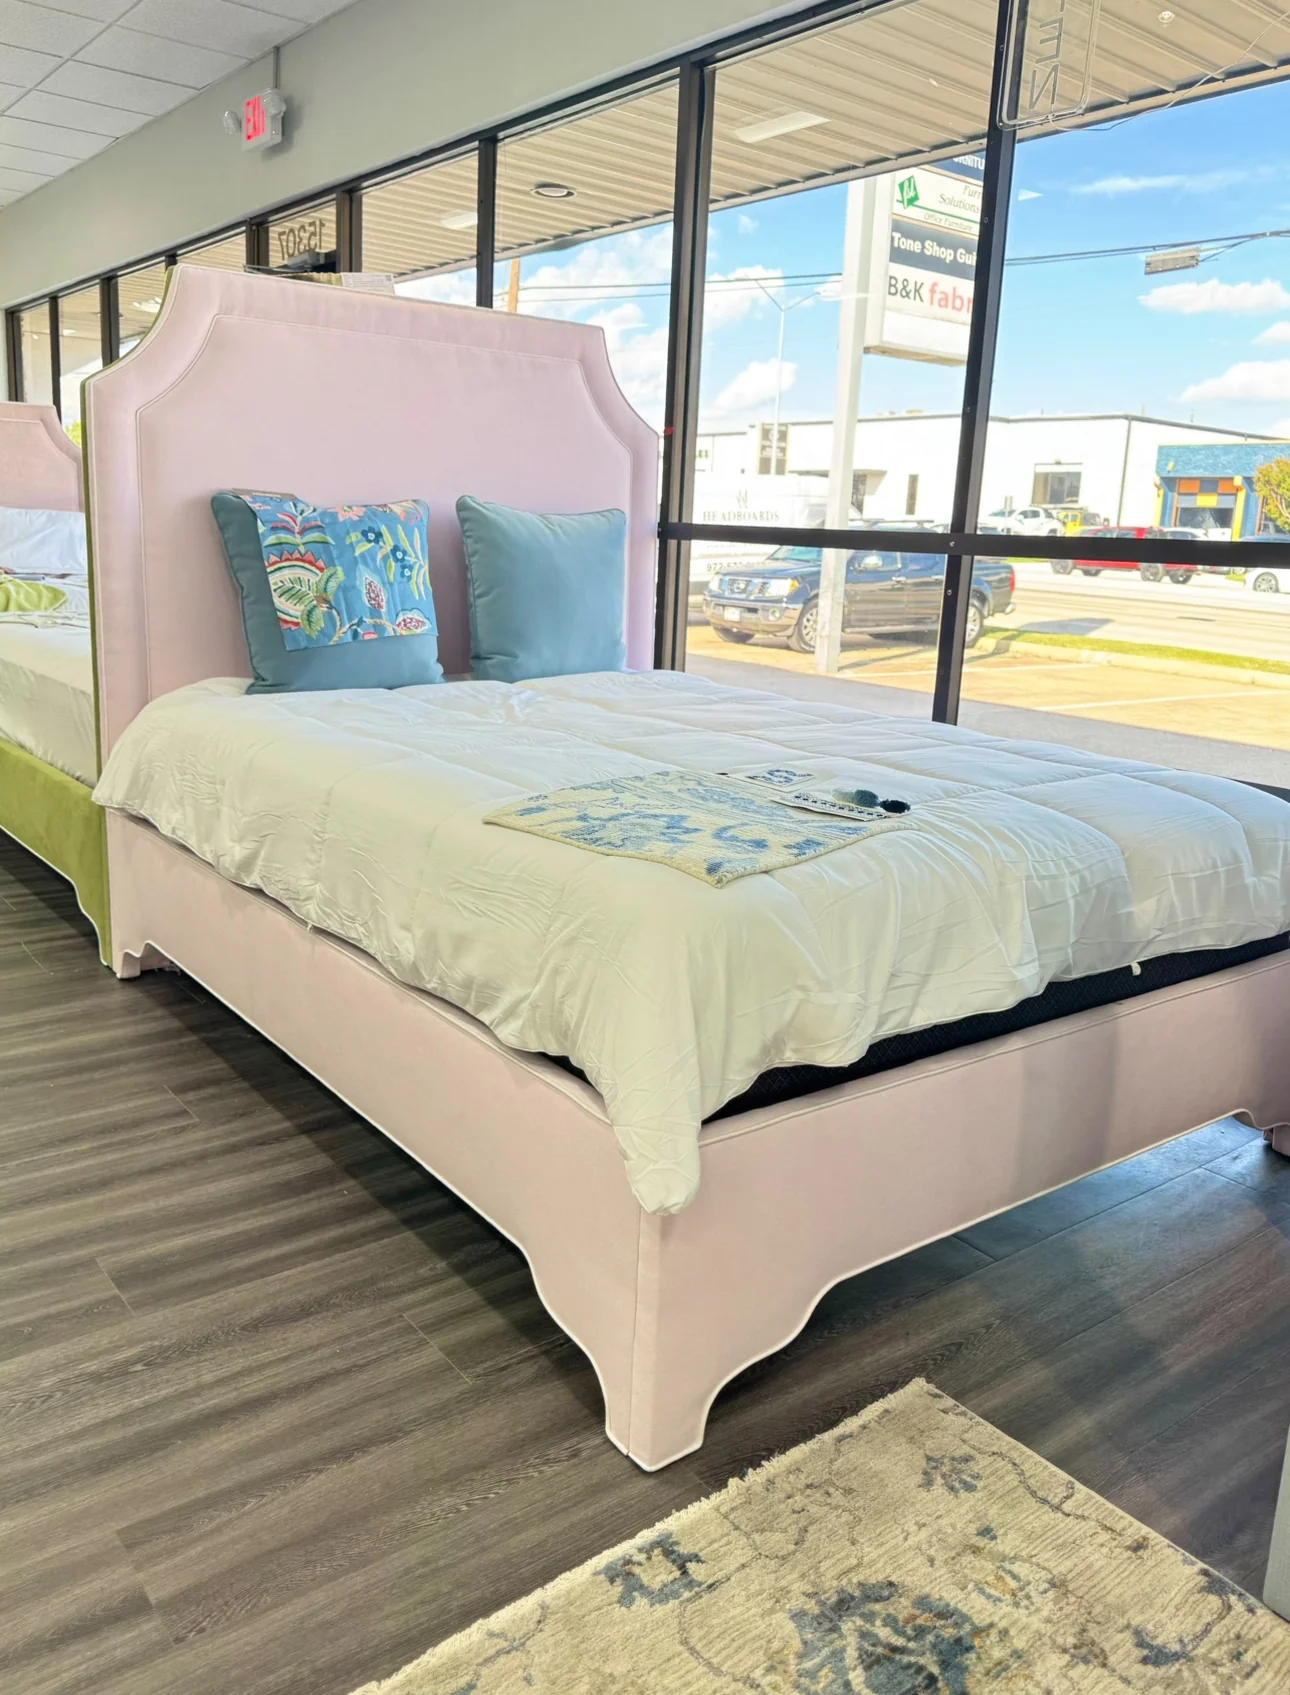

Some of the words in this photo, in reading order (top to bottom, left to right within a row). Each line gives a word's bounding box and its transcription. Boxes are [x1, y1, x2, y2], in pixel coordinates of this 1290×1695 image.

[938, 193, 980, 214] Solutions
[923, 212, 942, 225] Office
[943, 217, 973, 232] Furniture
[892, 231, 922, 253] Tone
[923, 239, 954, 264] Shop
[887, 275, 925, 303] B&K
[702, 510, 780, 522] HEADBOARDS
